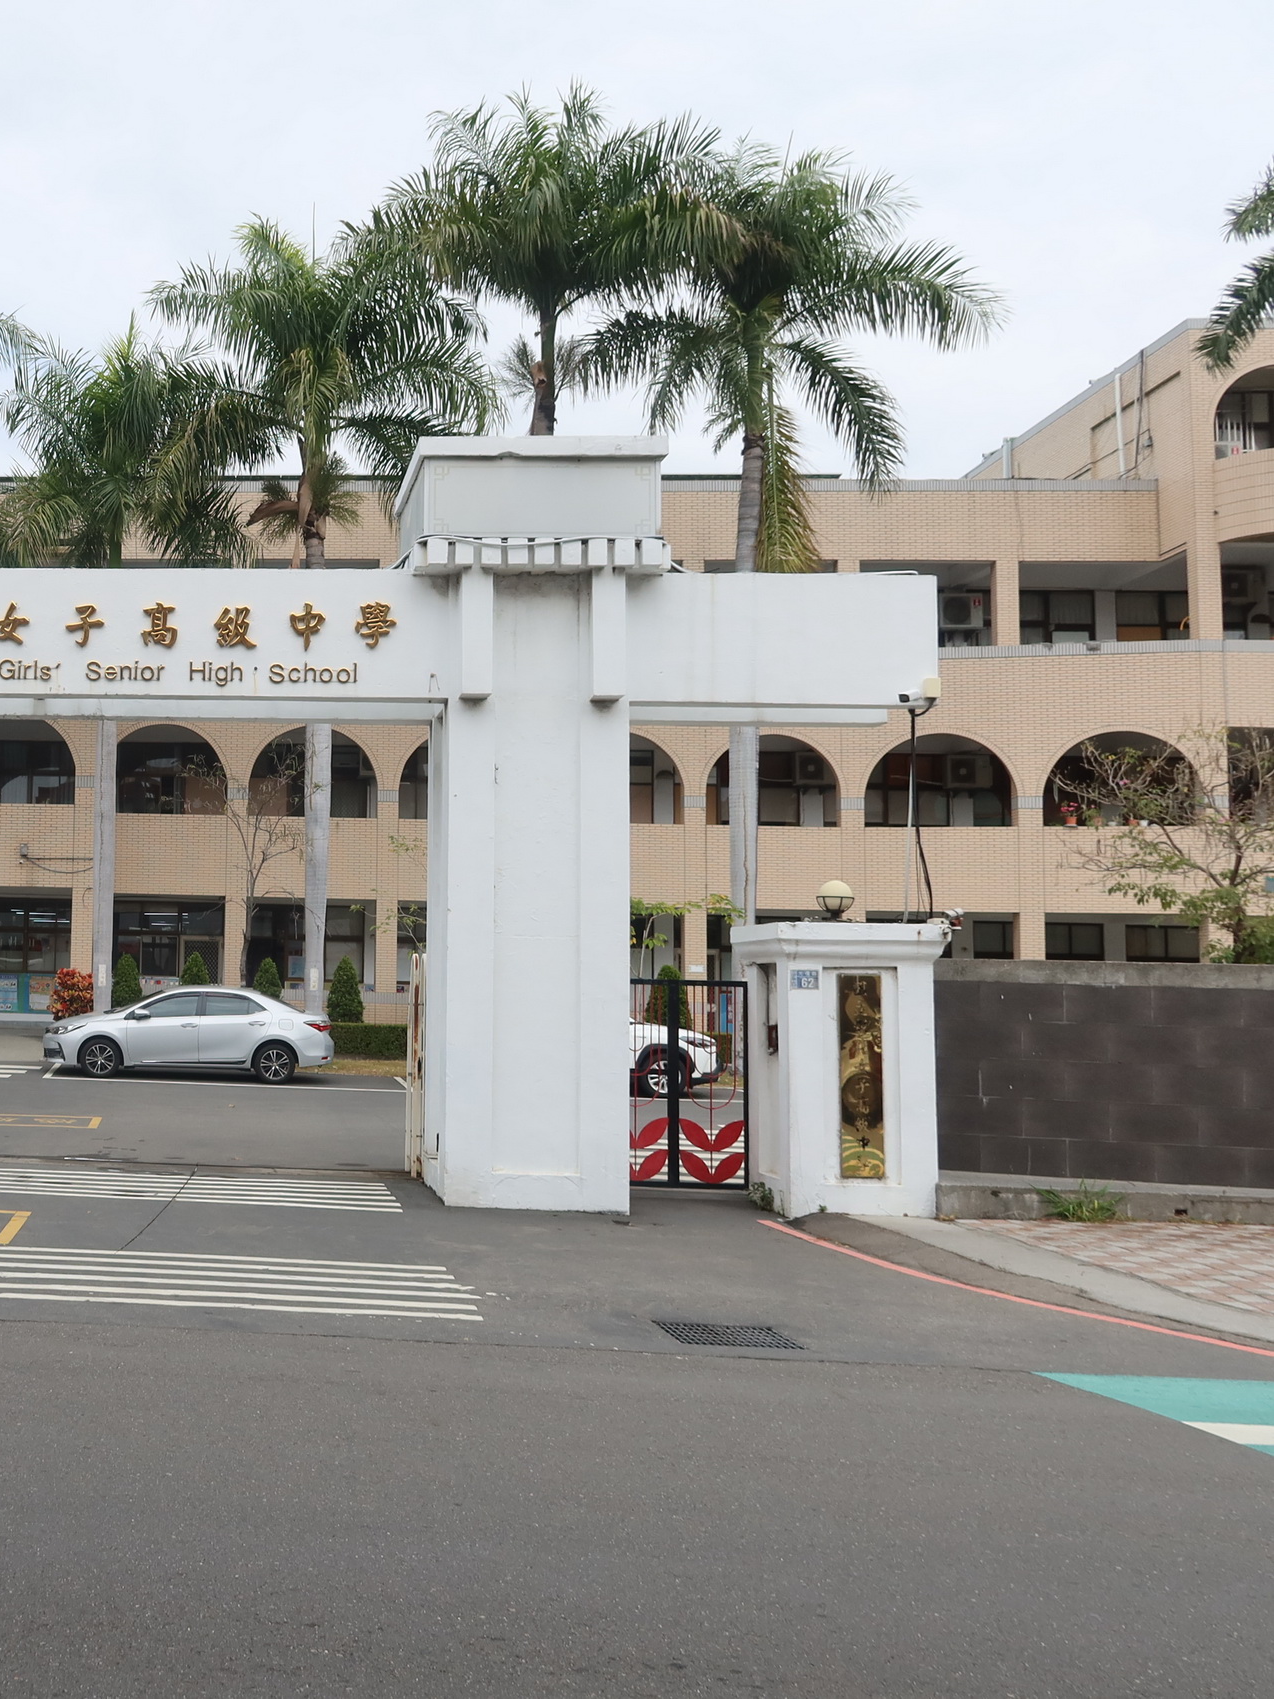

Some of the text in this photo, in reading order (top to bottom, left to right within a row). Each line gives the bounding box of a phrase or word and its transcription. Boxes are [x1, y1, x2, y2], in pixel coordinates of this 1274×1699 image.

[86, 660, 165, 682] Senior
[189, 660, 243, 687] High
[269, 662, 358, 684] School
[801, 977, 815, 989] 62
